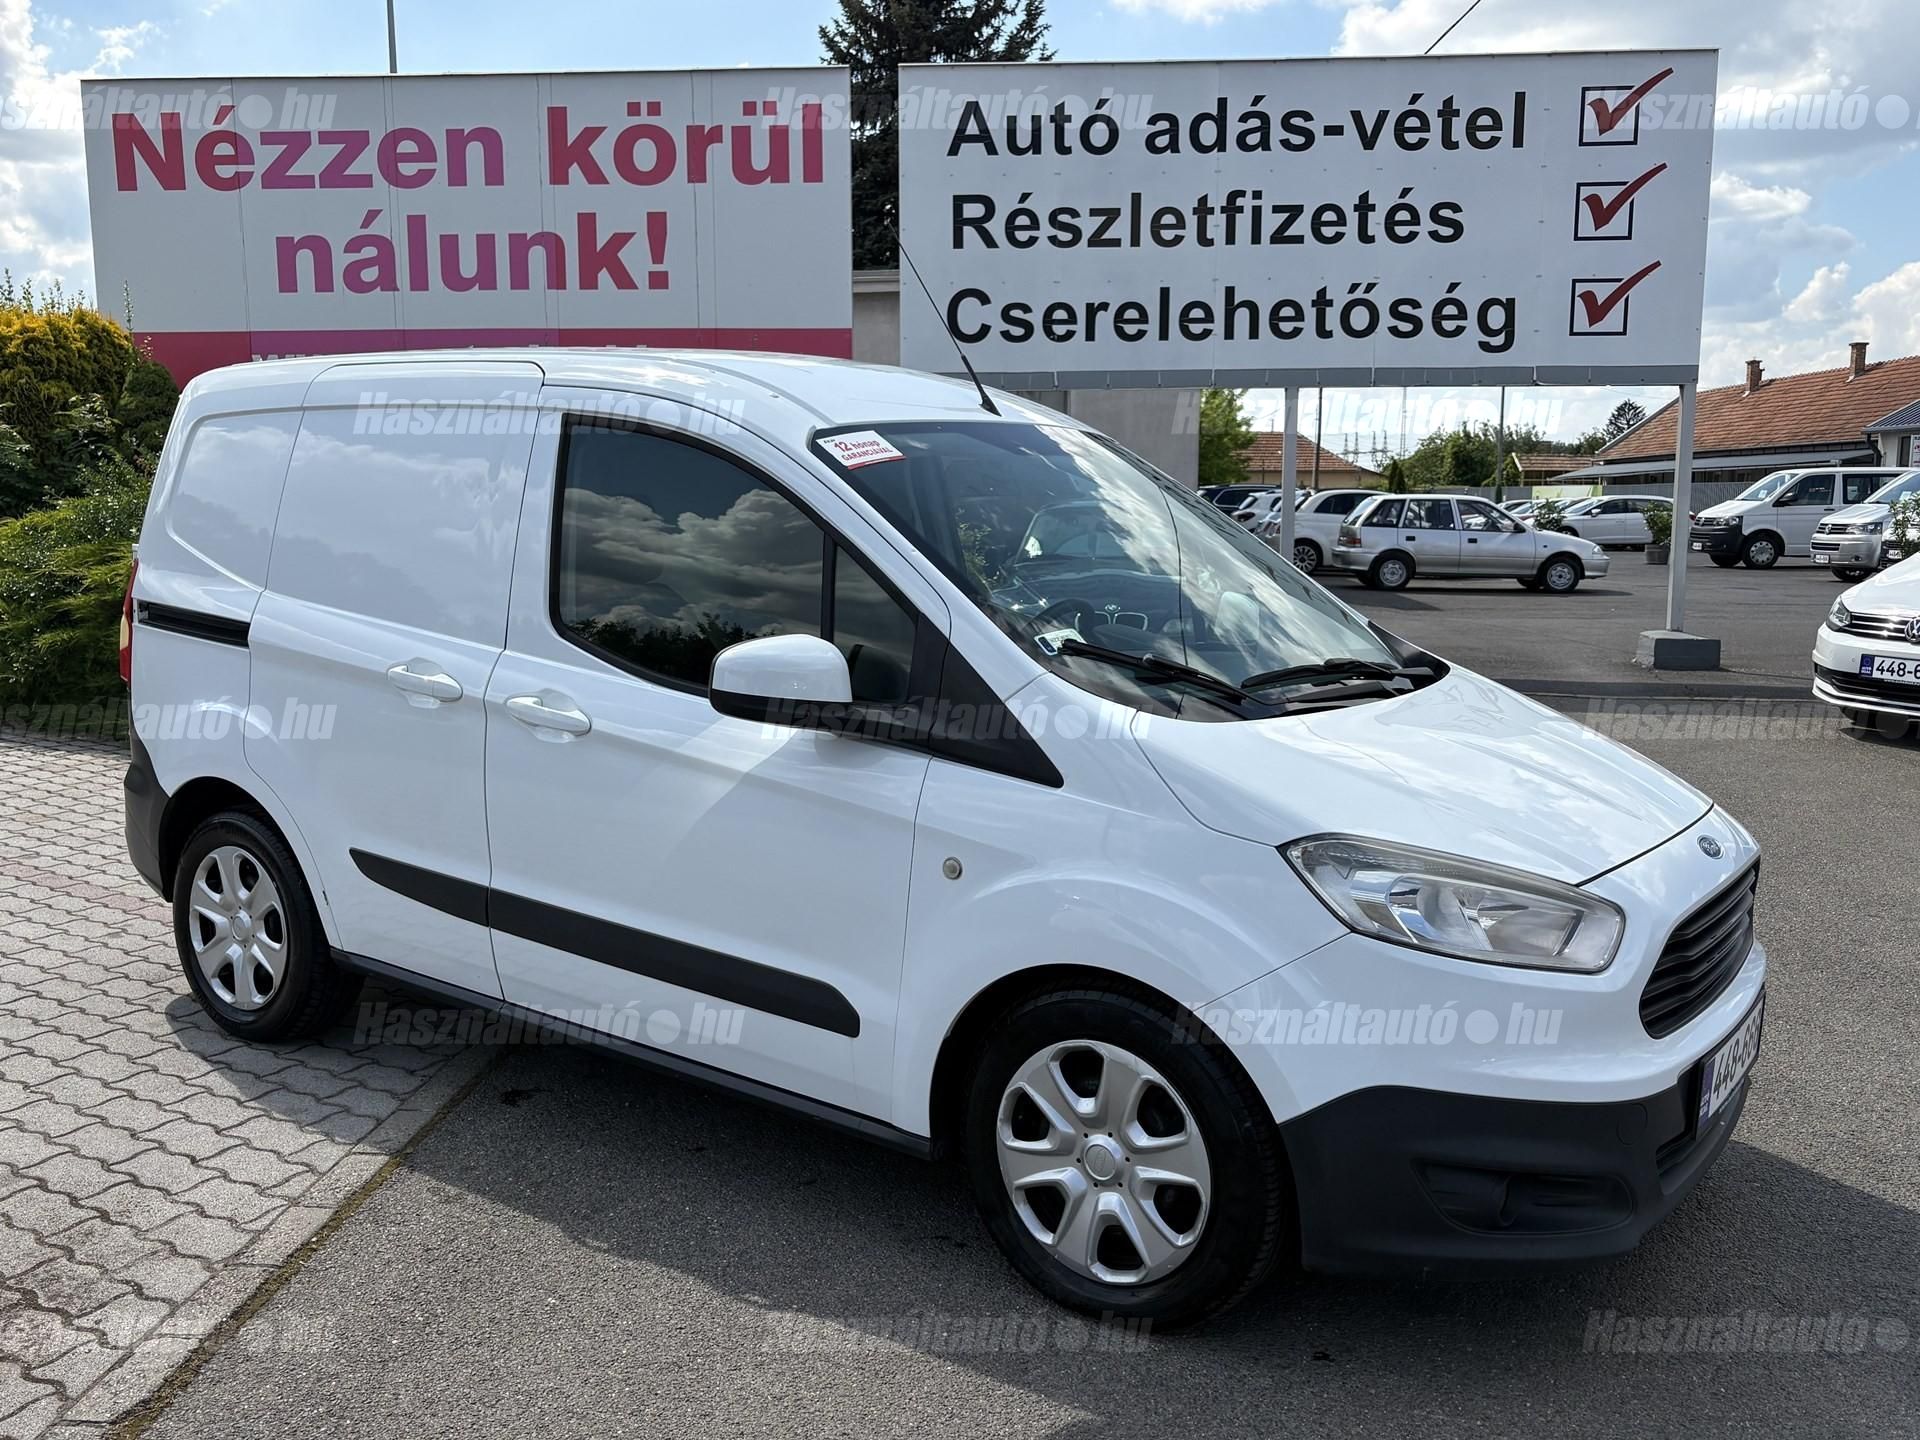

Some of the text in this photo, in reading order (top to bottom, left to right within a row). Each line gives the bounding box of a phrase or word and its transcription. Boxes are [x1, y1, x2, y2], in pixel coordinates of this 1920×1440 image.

[113, 101, 823, 191] Nézzen körül
[947, 92, 1526, 156] Autó adás-vétel
[278, 210, 668, 293] nálunk!
[952, 187, 1464, 249] Részletfizetés
[947, 282, 1516, 354] Cserelehetőség
[834, 441, 852, 452] 12
